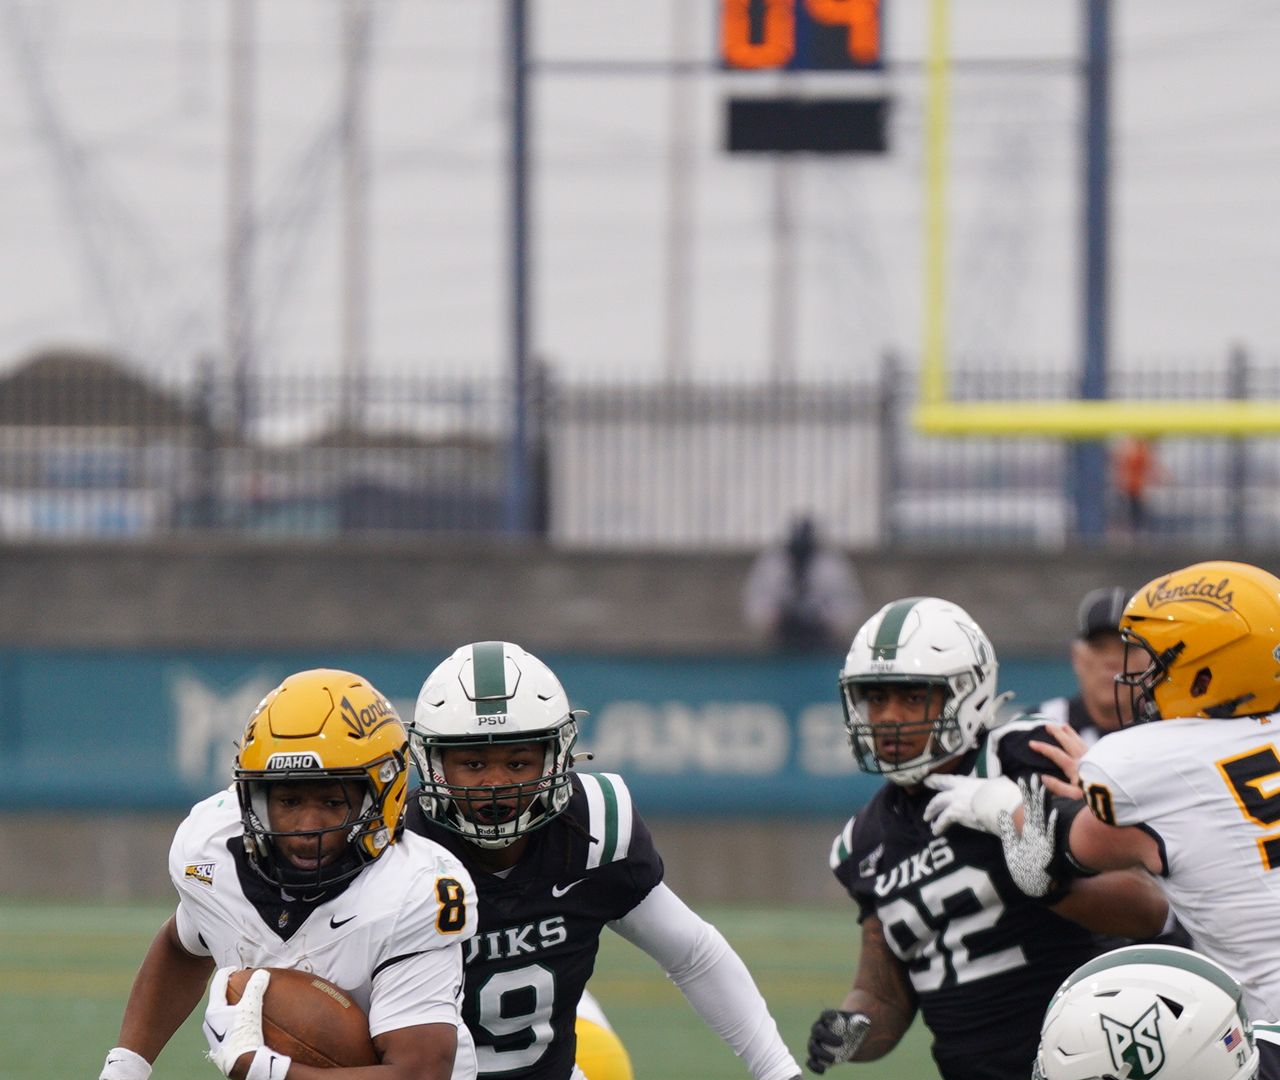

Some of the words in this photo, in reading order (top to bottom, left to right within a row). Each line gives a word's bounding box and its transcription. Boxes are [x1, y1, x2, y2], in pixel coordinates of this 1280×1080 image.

[1145, 577, 1235, 612] Vandals
[478, 716, 507, 725] PSU
[271, 755, 314, 770] IDAHO
[196, 864, 214, 877] SKY
[435, 876, 466, 936] 8
[877, 865, 1027, 993] 92
[475, 962, 556, 1076] 9
